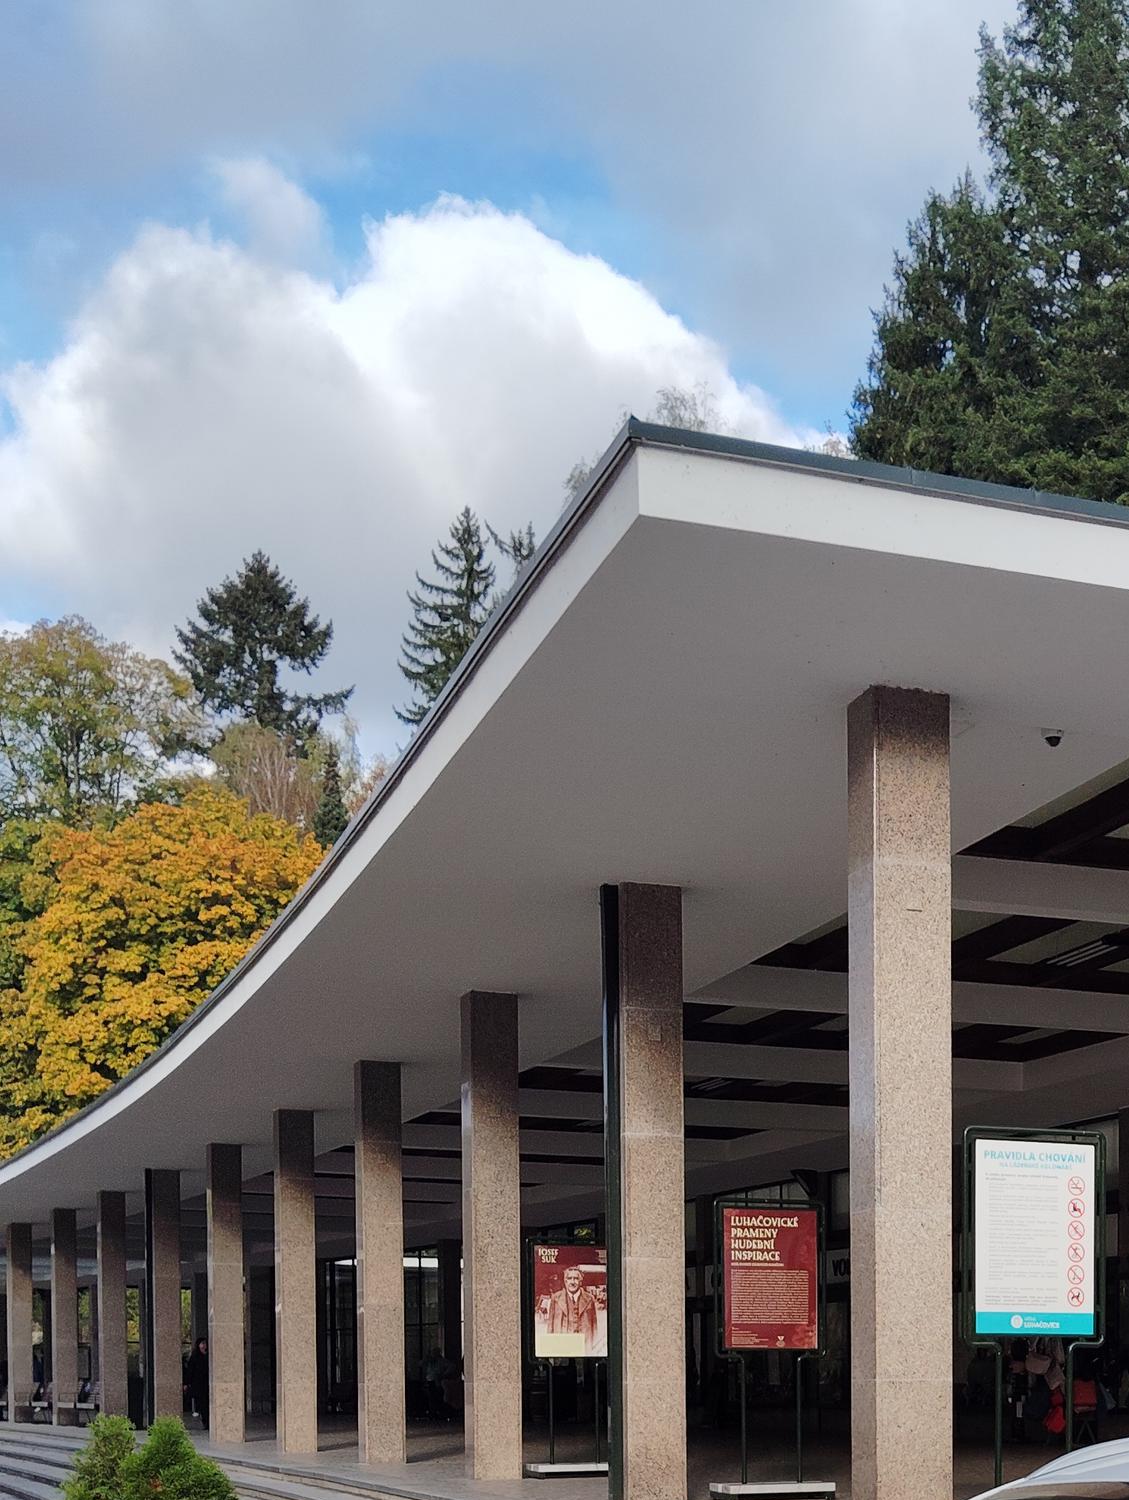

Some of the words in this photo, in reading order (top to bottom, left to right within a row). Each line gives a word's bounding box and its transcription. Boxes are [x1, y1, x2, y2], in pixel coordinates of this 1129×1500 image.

[983, 1150, 1036, 1160] PRAVIDLA
[1039, 1151, 1086, 1163] CHOVÁNÍ
[731, 1215, 799, 1228] LUHAČOVICKÉ
[731, 1228, 778, 1238] PRAMENY
[731, 1239, 774, 1249] HUDEBNÍ
[541, 1256, 557, 1264] SUK
[731, 1251, 780, 1261] INSPIRACE
